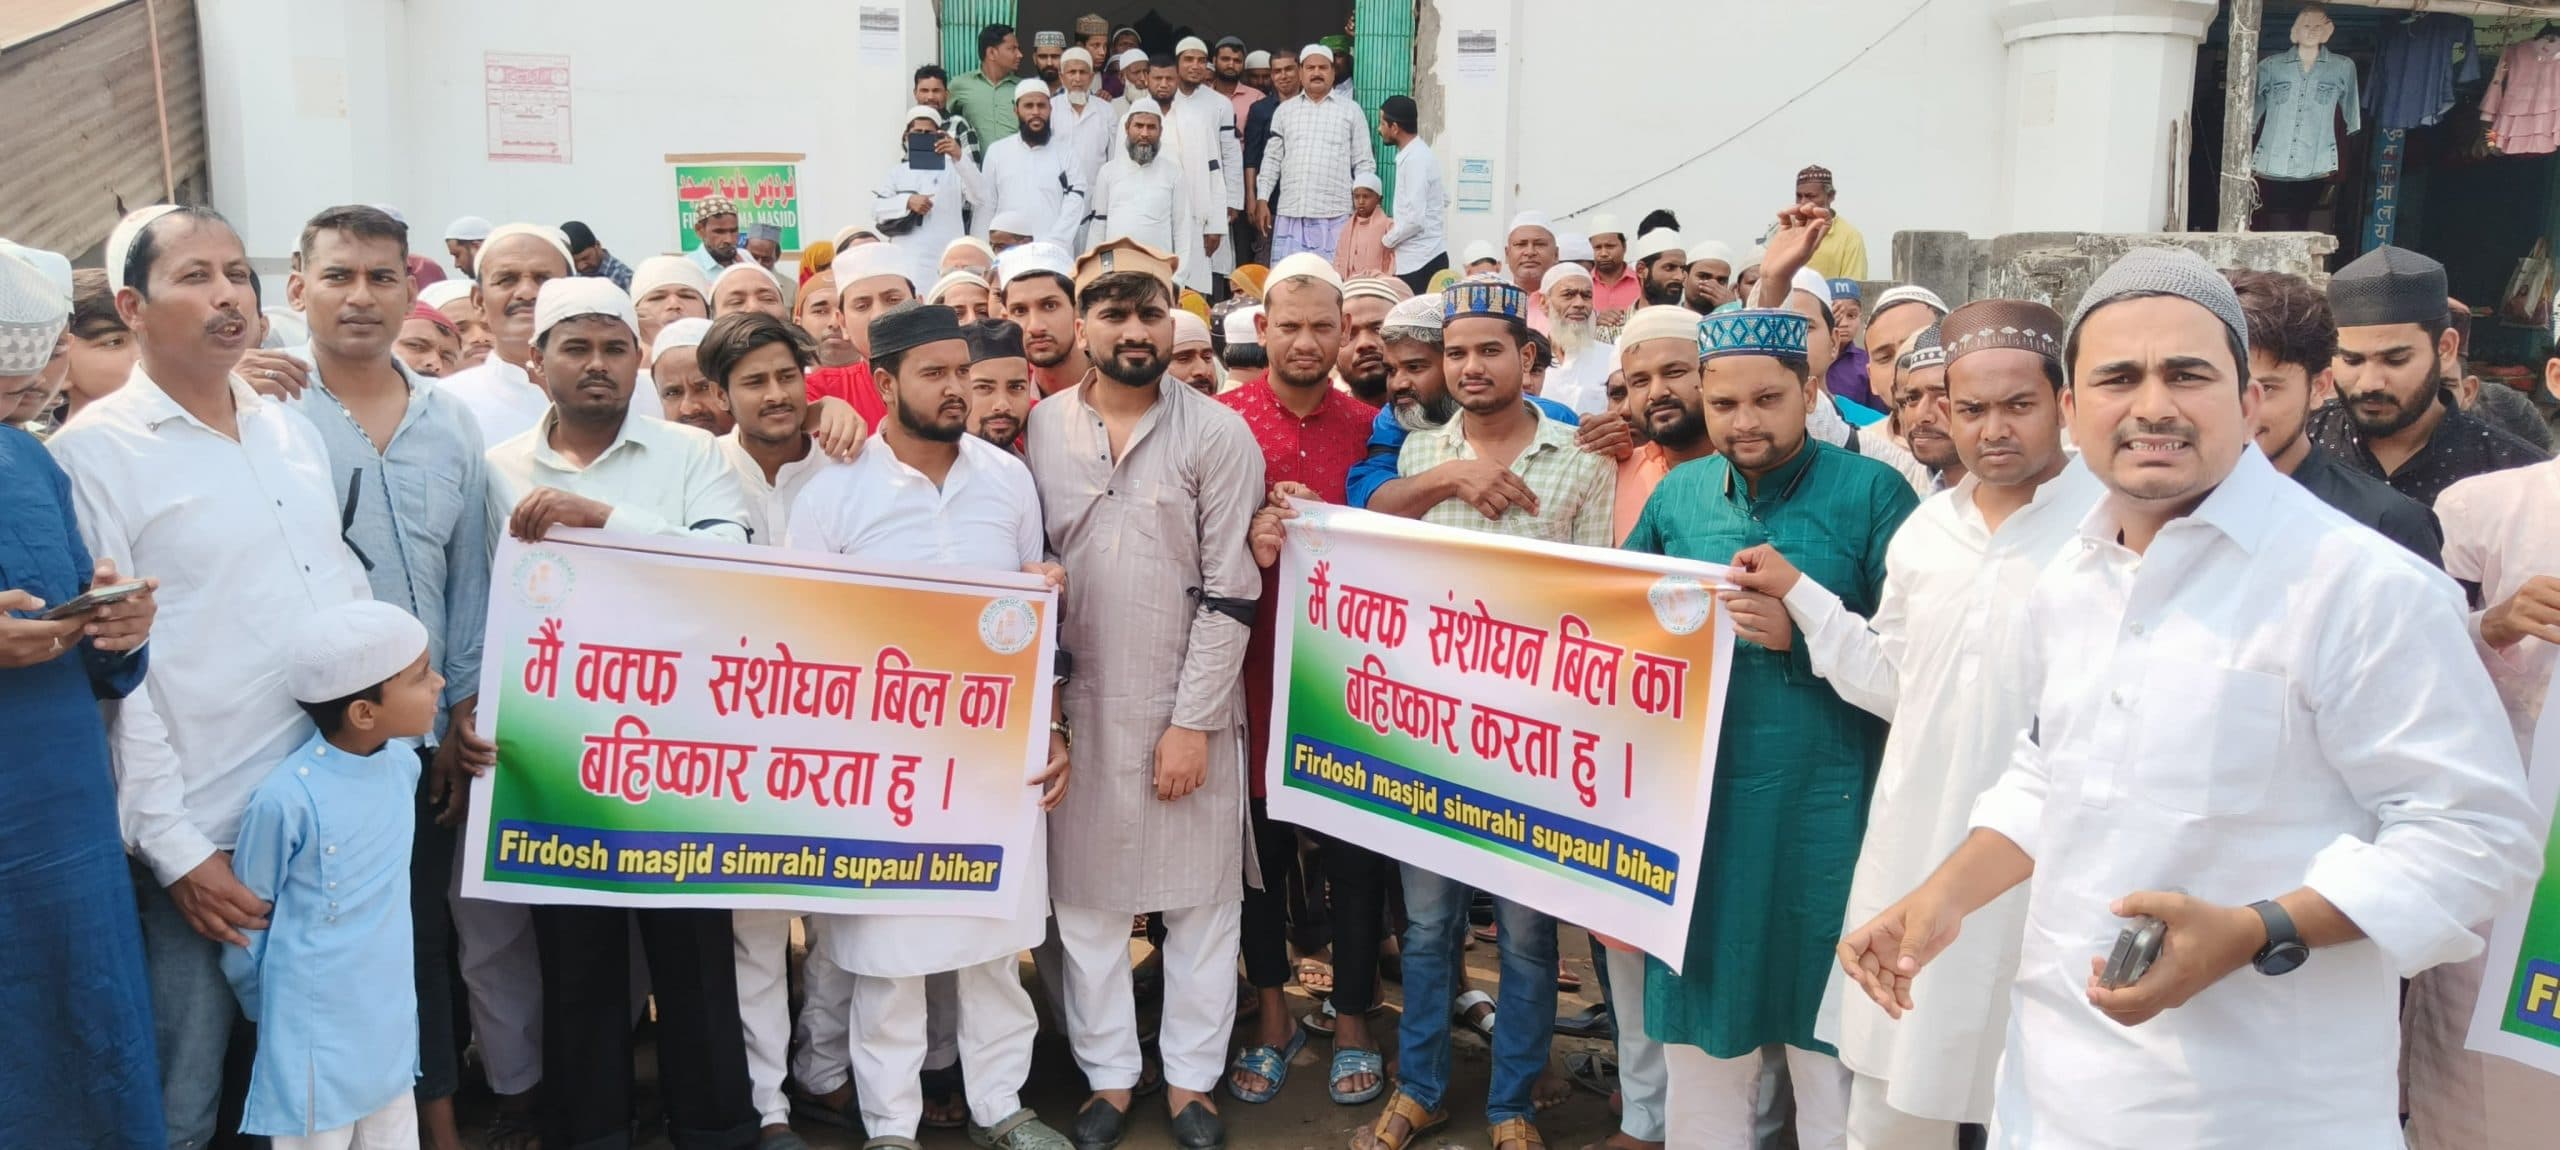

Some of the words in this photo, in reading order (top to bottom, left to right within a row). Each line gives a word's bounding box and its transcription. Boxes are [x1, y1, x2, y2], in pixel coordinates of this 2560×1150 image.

[524, 616, 564, 698] मैं
[575, 643, 682, 707] वक्फ
[871, 647, 953, 728] बिल
[959, 674, 1014, 730] का
[1308, 560, 1331, 630] मैं
[1337, 584, 1409, 650] वक्फ
[1552, 613, 1624, 706] बिल
[1631, 652, 1689, 720] का
[581, 715, 758, 803] बहिष्कार
[767, 746, 880, 808] करता
[886, 754, 923, 828] हु
[1346, 653, 1463, 755] बहिष्कार
[1470, 703, 1562, 780] करता
[1571, 730, 1601, 809] हु
[499, 829, 609, 871] Firdosh
[617, 842, 714, 884] masjid
[721, 844, 826, 878] simrahi
[832, 853, 924, 888] supaul
[929, 854, 999, 884] bihar
[1294, 743, 1367, 791] Firdosh
[1372, 773, 1438, 816] masjid
[1443, 796, 1526, 844] simrahi
[1532, 823, 1611, 872] supaul
[1615, 843, 1676, 896] bihar
